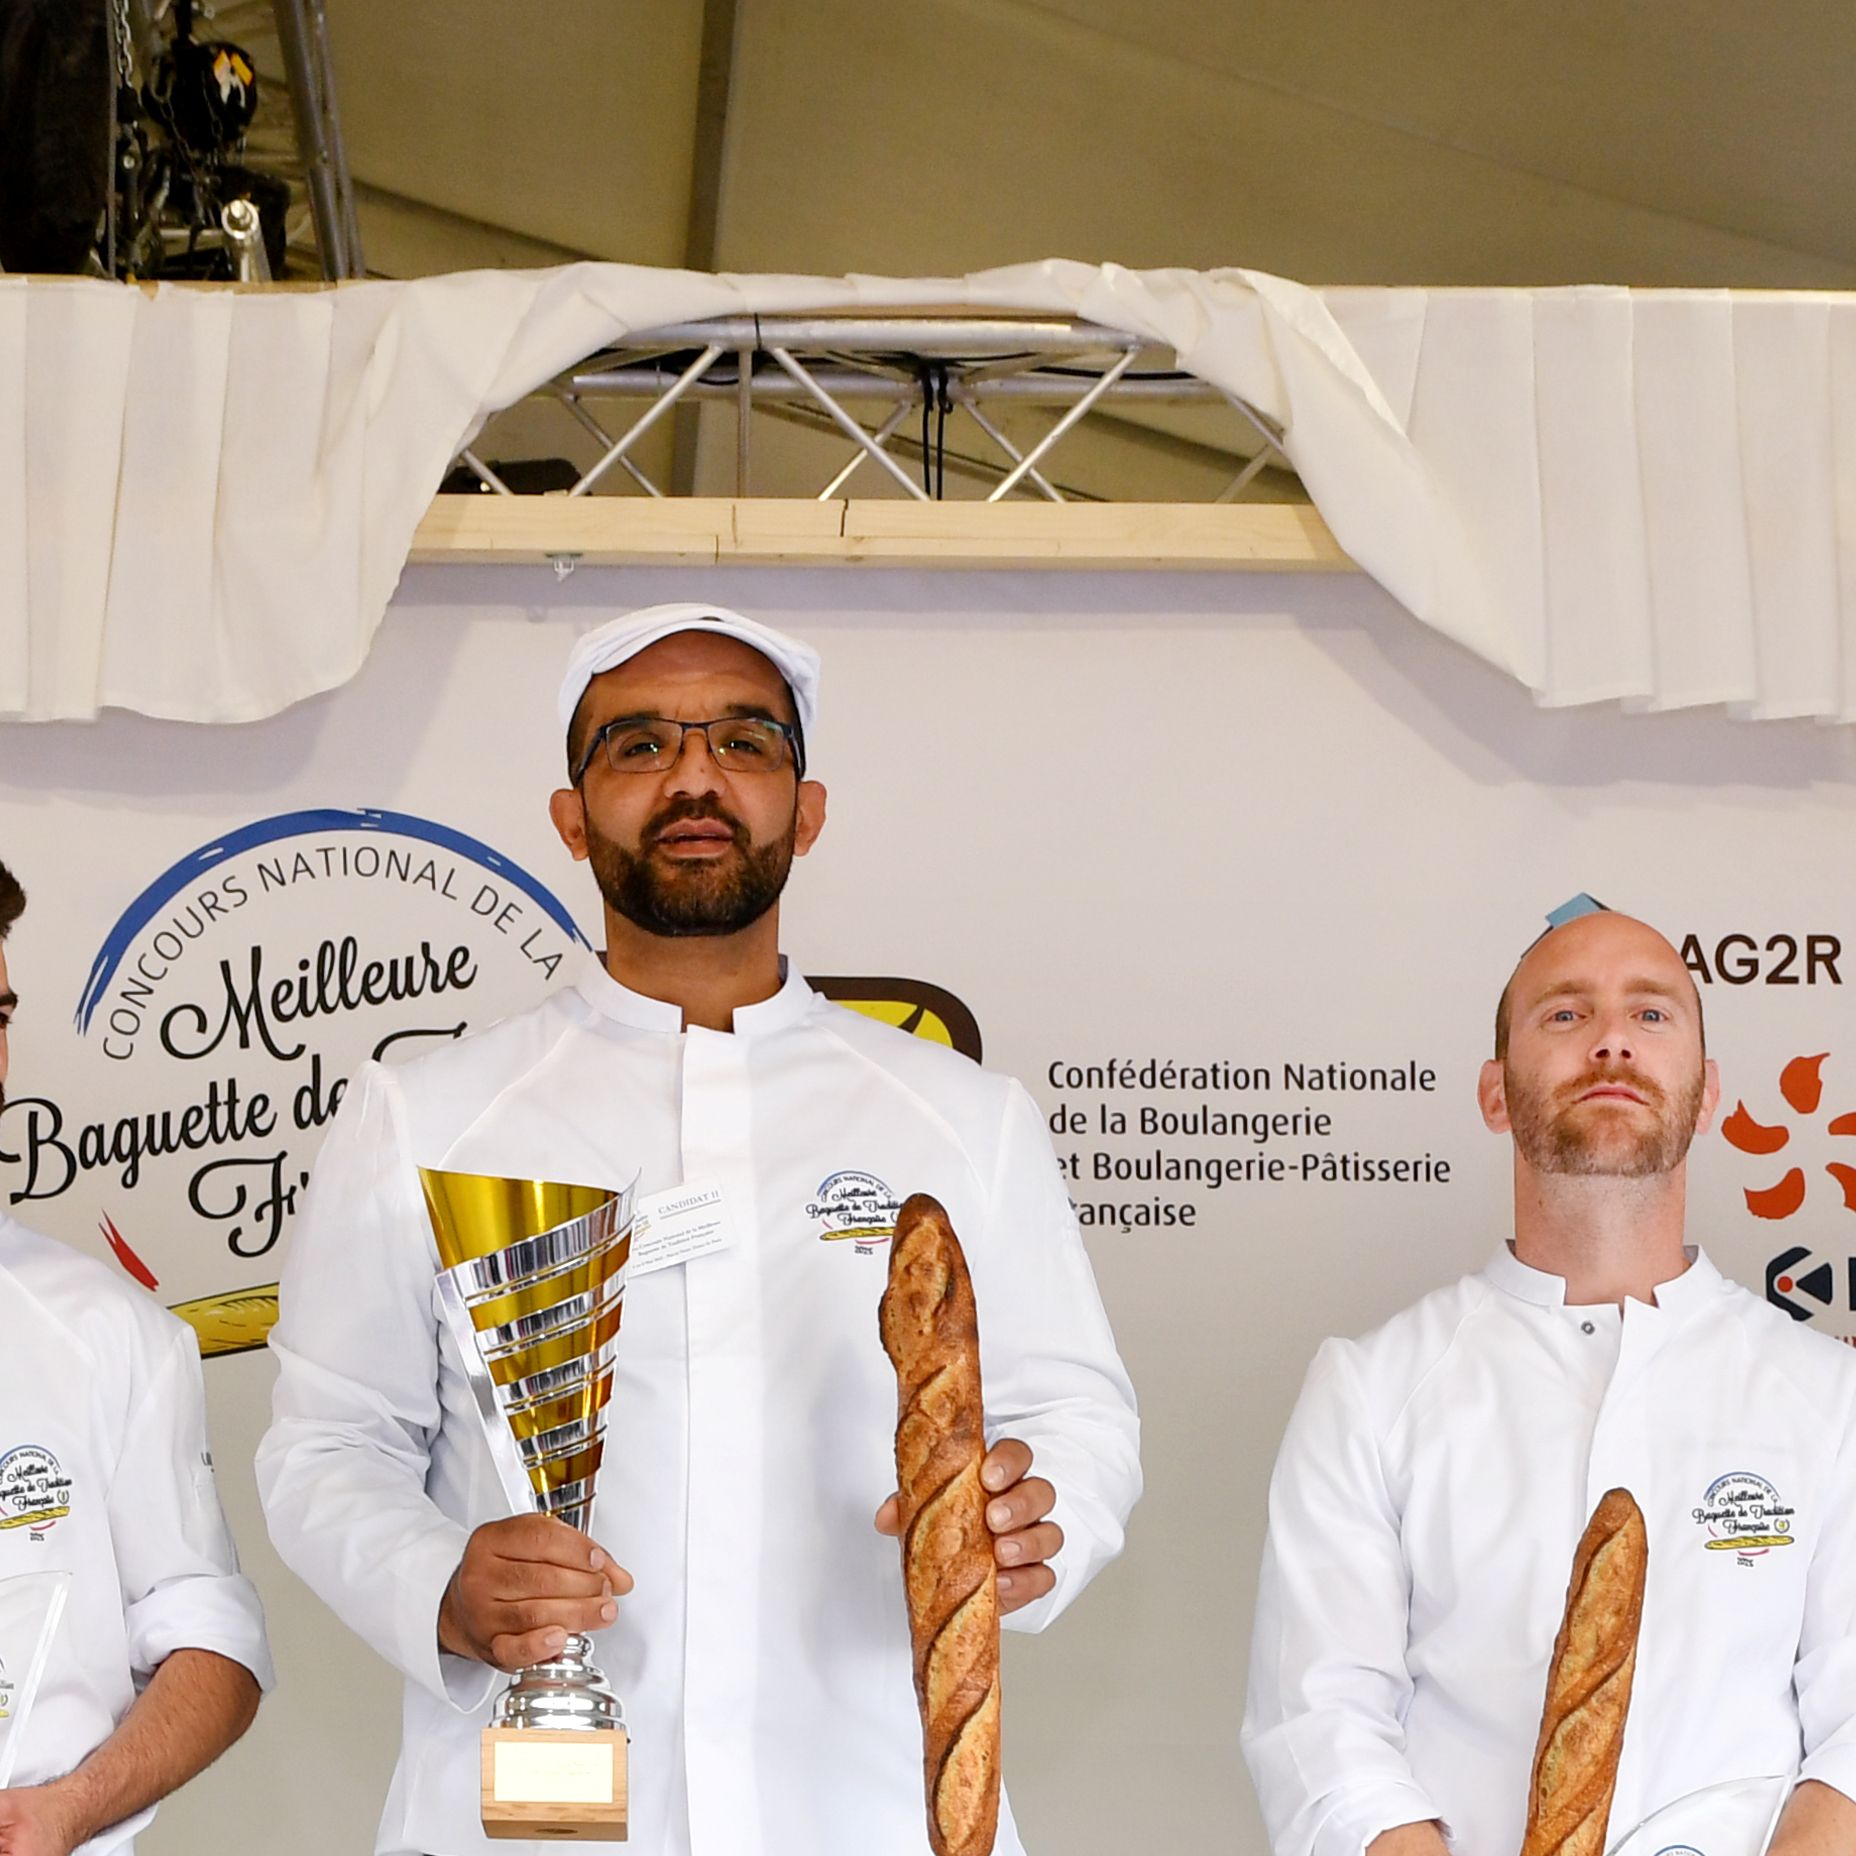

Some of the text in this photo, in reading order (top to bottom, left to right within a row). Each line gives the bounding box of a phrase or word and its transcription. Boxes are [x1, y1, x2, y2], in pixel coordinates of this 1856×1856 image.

[102, 845, 564, 1062] CONCOURS NATIONAL DE LA
[1679, 934, 1842, 985] AG2R
[159, 936, 479, 1062] Meilleure
[1048, 1058, 1436, 1092] Confédération Nationale
[1049, 1103, 1332, 1144] de la Boulangerie
[1093, 1149, 1451, 1190] Boulangerie-Pâtisserie
[1068, 1196, 1197, 1233] ançaise
